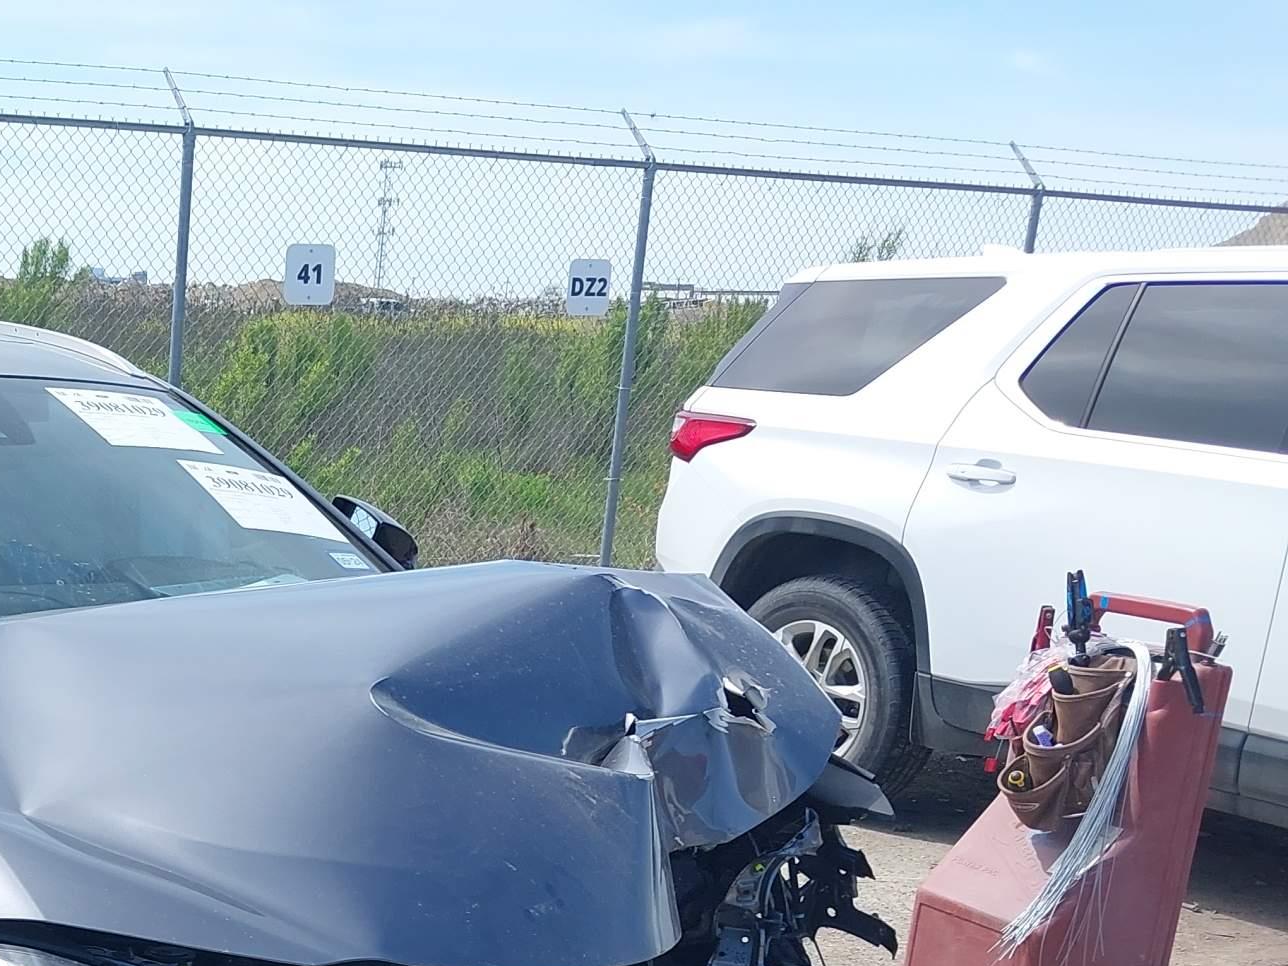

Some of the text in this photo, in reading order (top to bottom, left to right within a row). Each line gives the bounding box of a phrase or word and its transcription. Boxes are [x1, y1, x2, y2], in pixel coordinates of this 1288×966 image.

[297, 263, 322, 285] 41
[570, 277, 608, 297] DZ2
[74, 400, 167, 418] 39081029
[205, 475, 295, 499] 39081029
